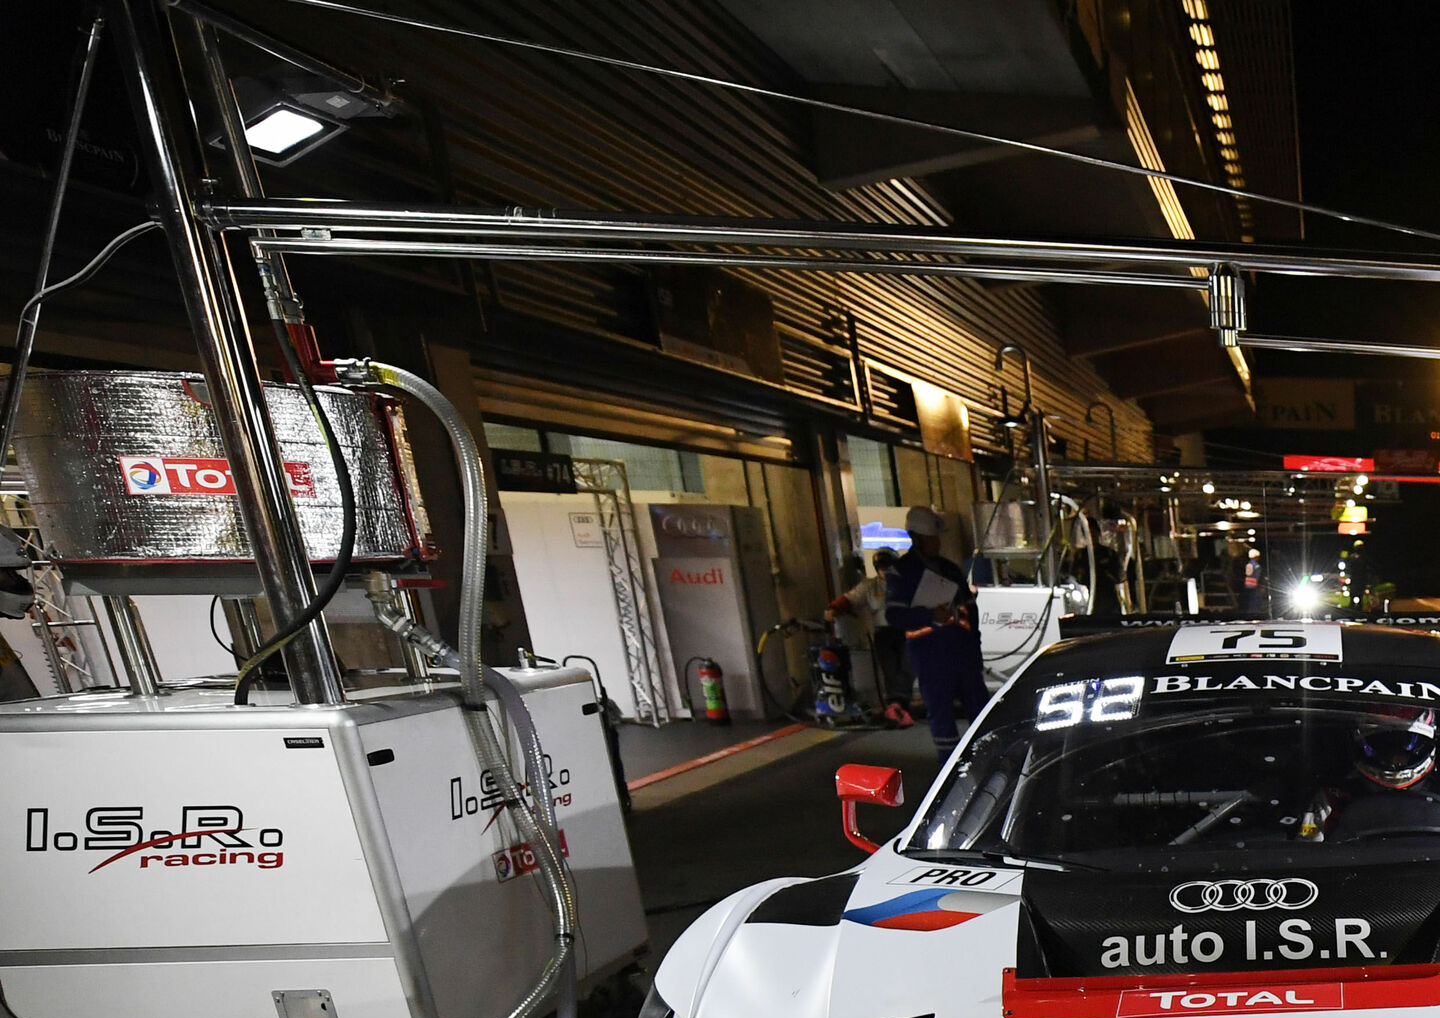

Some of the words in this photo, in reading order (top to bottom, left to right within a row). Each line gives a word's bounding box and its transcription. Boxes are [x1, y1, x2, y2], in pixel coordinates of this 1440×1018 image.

[669, 567, 724, 585] Audi
[1210, 630, 1306, 649] 75
[26, 804, 284, 852] I.S.R.
[140, 850, 284, 869] racing
[910, 868, 997, 887] PRO
[1100, 923, 1225, 969] auto
[1245, 916, 1389, 961] I.S.R.
[1149, 990, 1316, 1010] TOTAL
